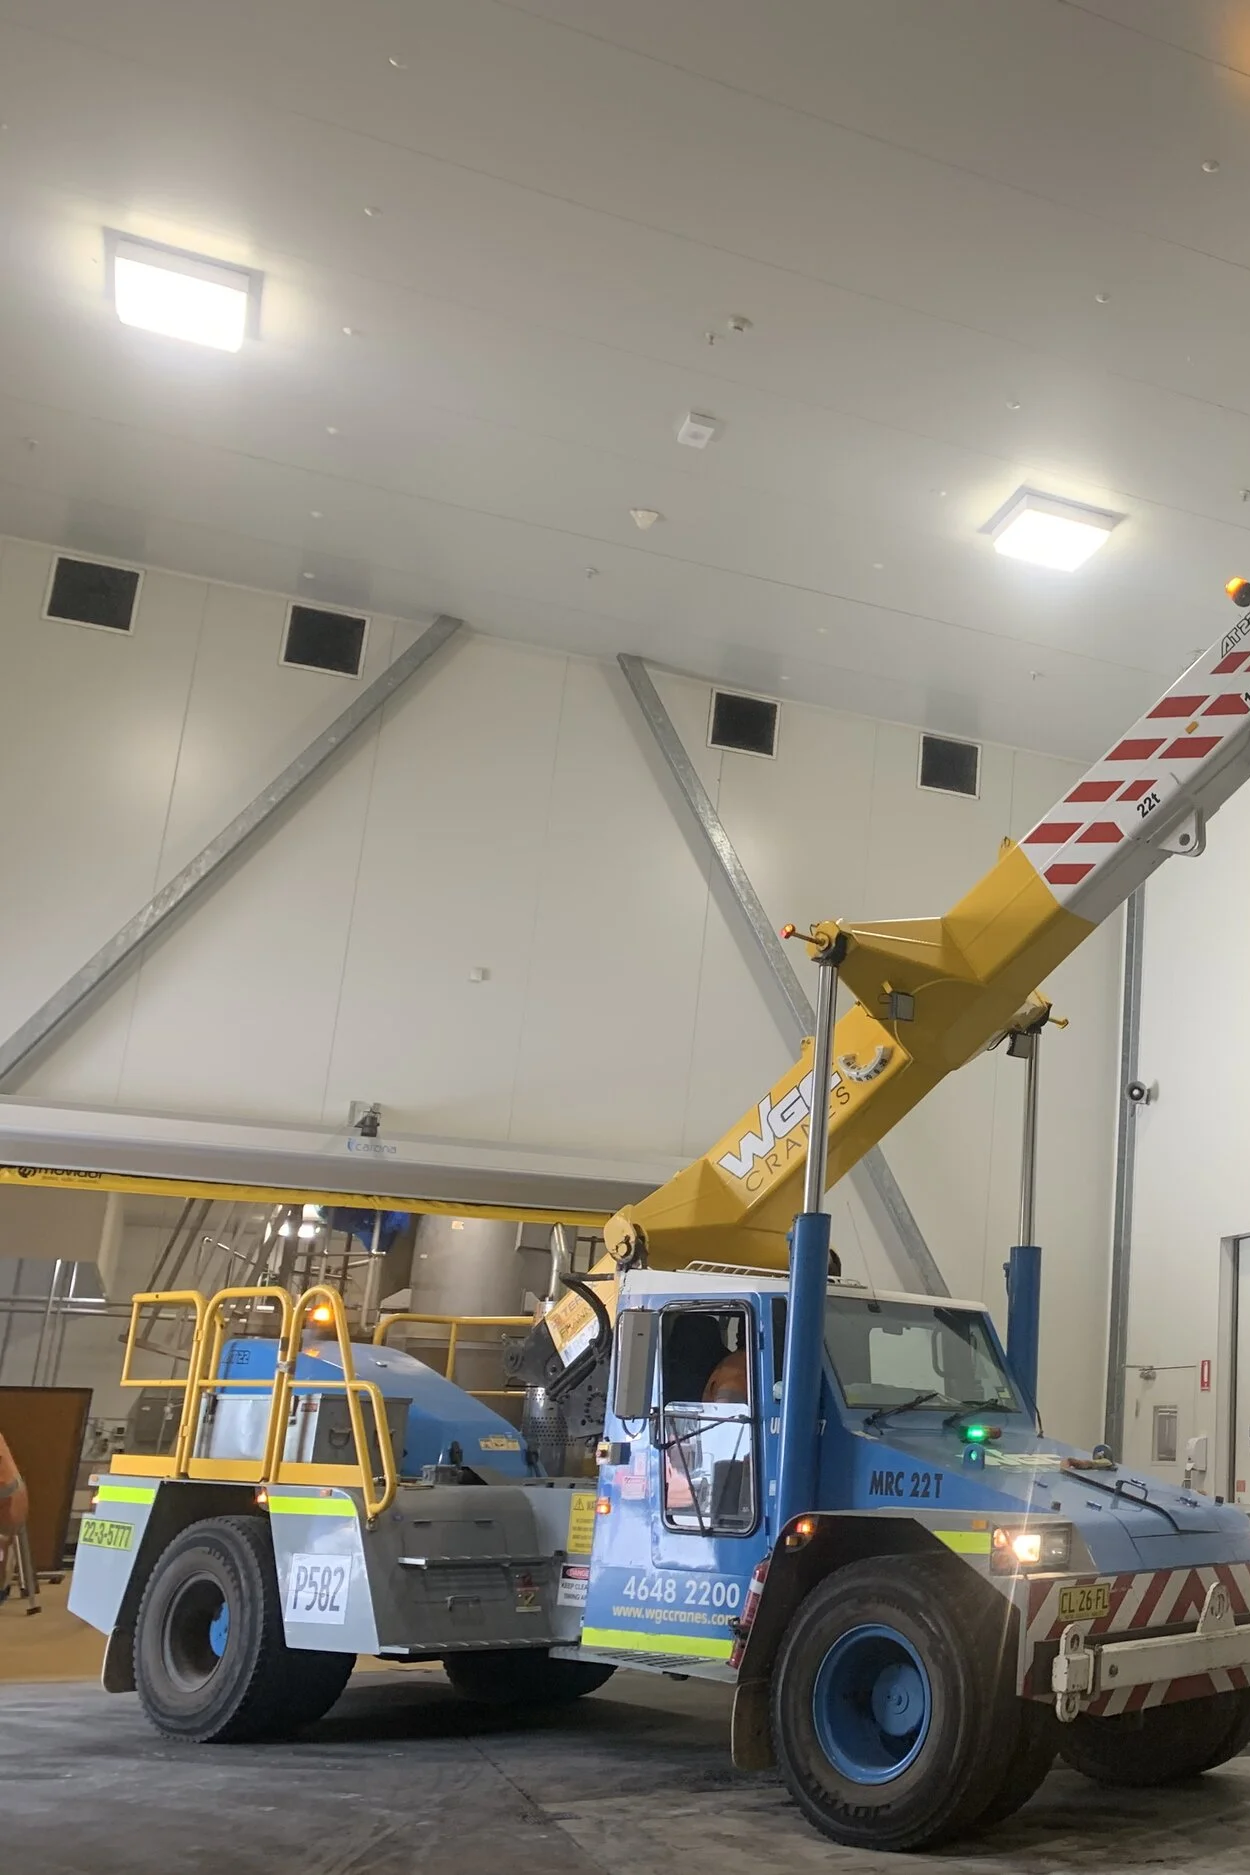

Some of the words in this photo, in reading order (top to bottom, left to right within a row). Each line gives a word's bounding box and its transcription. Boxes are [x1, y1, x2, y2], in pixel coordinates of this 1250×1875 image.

[1136, 792, 1161, 818] 22t
[745, 1086, 850, 1192] CRAS
[869, 1470, 905, 1497] MRC
[82, 1520, 132, 1548] 22-3-5777
[292, 1565, 345, 1612] P582
[623, 1575, 677, 1604] 4648
[684, 1580, 740, 1608] 2200
[1061, 1592, 1075, 1613] CL
[1079, 1590, 1092, 1612] 26
[1096, 1588, 1107, 1609] FL
